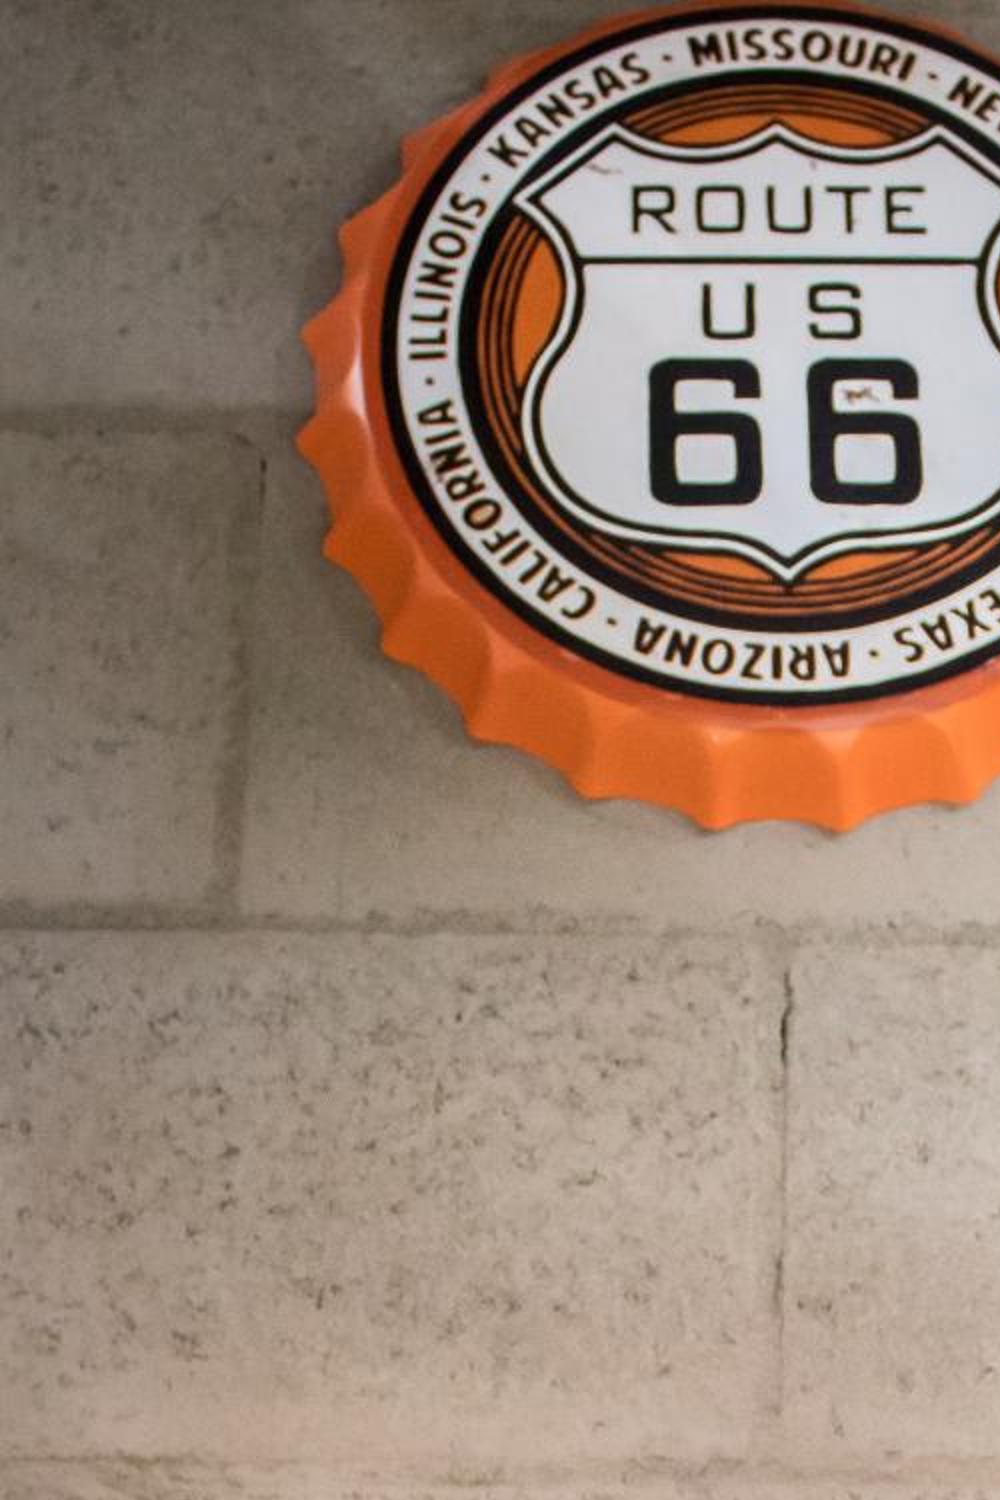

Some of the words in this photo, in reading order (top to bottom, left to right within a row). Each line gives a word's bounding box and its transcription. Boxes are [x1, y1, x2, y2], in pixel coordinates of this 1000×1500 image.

[488, 52, 651, 168] KANSAS
[686, 28, 917, 81] MISSOURI
[632, 185, 927, 234] ROUTE
[409, 191, 486, 361] ILLINOIS
[649, 357, 923, 507] 66
[416, 398, 597, 620] CALIFORNIA
[634, 617, 851, 681] ARIZONA
